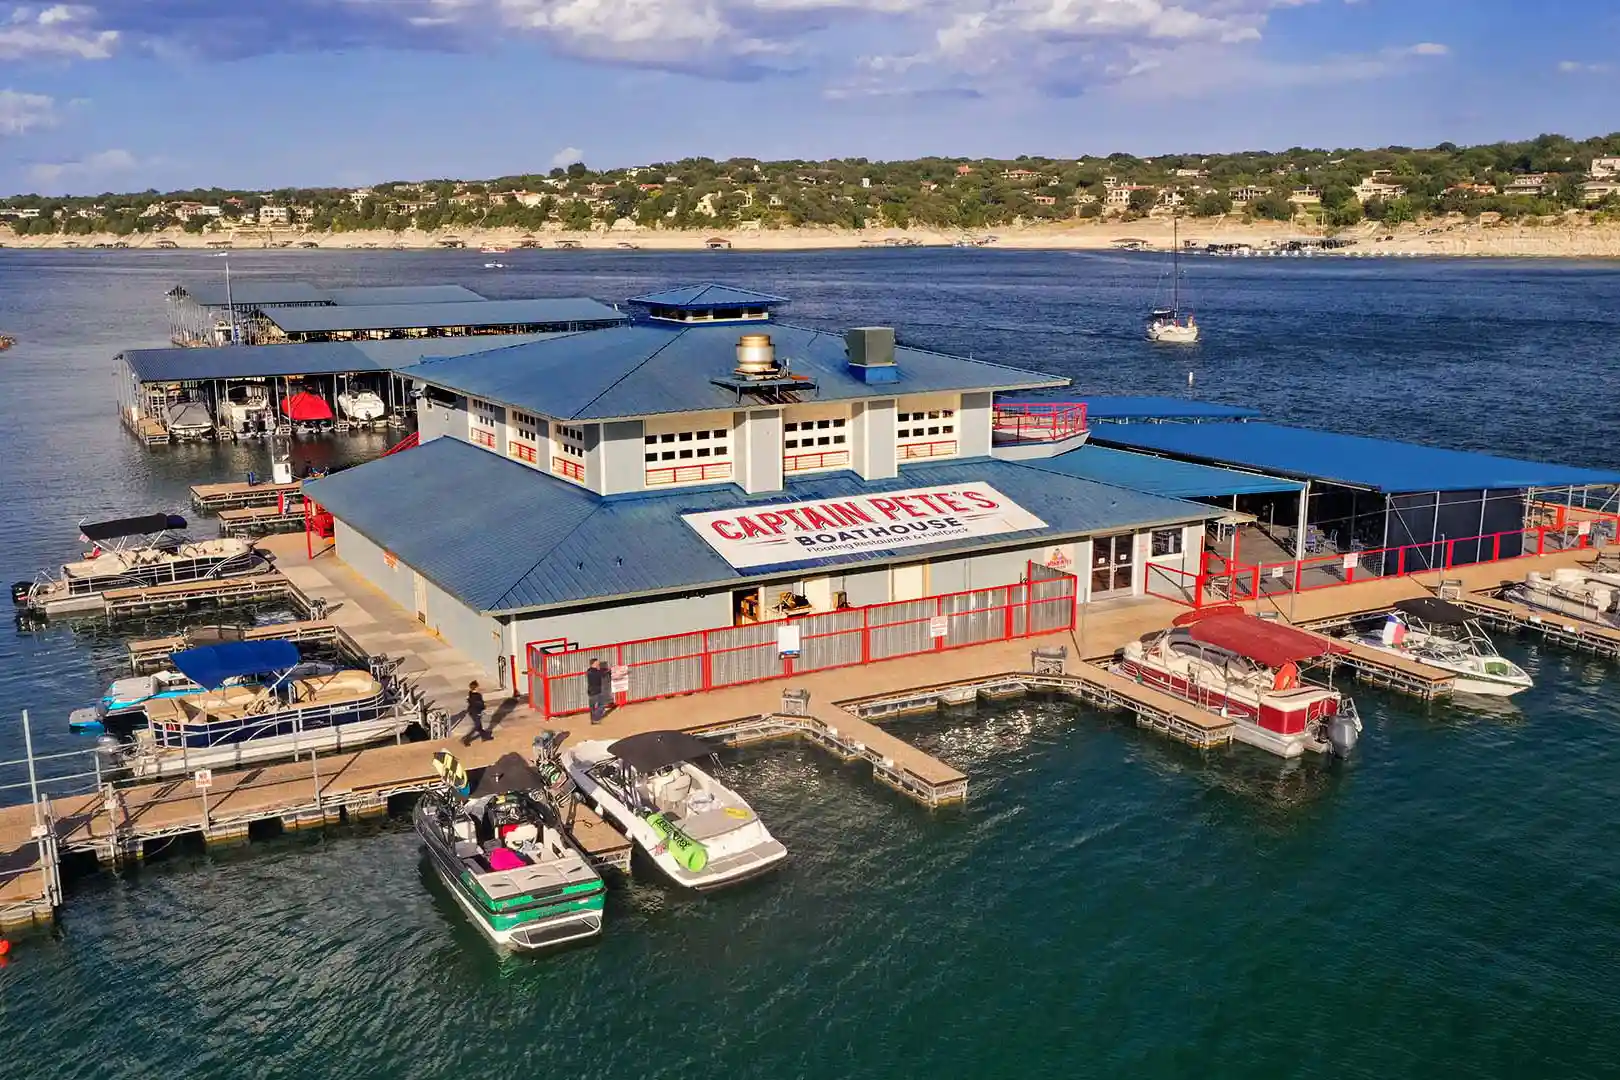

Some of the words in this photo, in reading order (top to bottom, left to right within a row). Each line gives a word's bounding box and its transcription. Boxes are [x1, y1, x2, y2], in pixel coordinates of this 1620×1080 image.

[711, 501, 877, 540] CAPTAIN
[866, 491, 998, 521] PETE'S
[794, 517, 963, 546] BOATHOUSE
[806, 542, 854, 553] Floating
[853, 534, 912, 548] Restaurant
